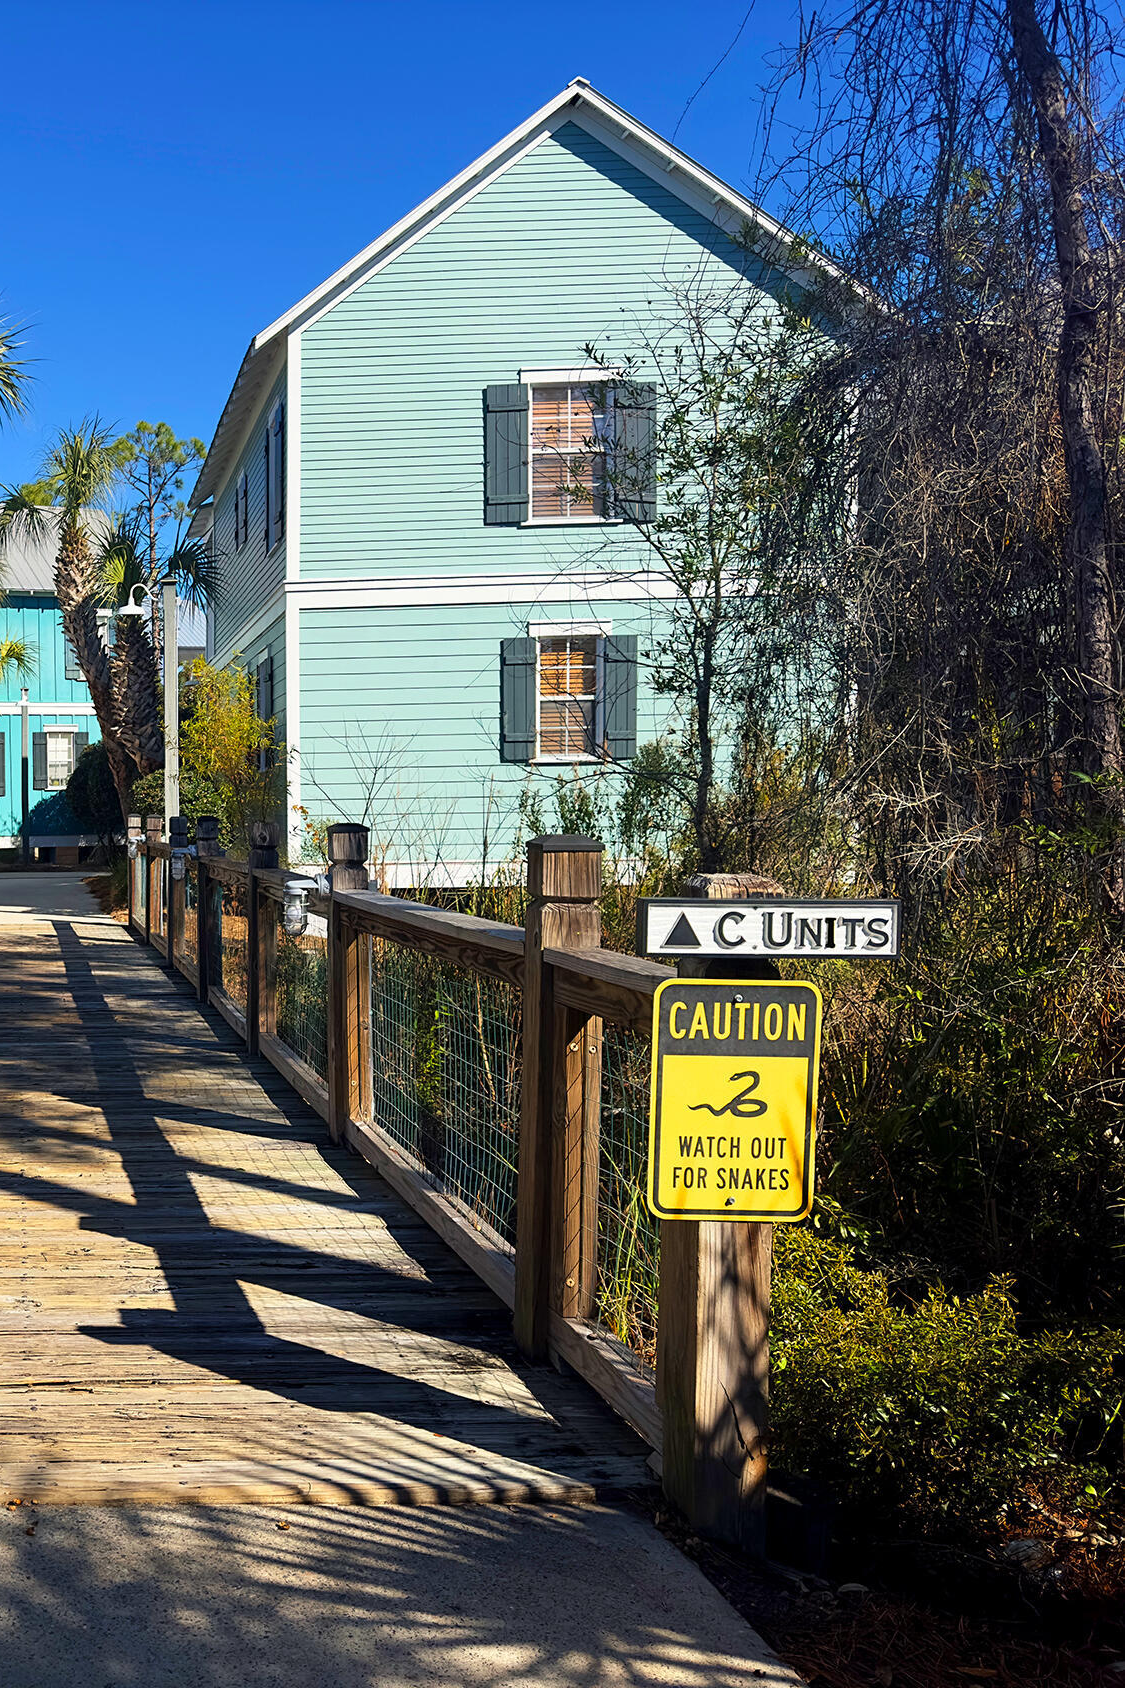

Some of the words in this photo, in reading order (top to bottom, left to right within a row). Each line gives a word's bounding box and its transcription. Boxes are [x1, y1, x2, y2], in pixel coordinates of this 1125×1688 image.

[714, 911, 747, 949] C
[761, 911, 890, 950] UNITS
[669, 1001, 807, 1042] CAUTION
[678, 1135, 741, 1159] WATCH
[750, 1136, 787, 1160] OUT
[672, 1166, 708, 1189] FOR
[716, 1167, 790, 1191] SNAKES
